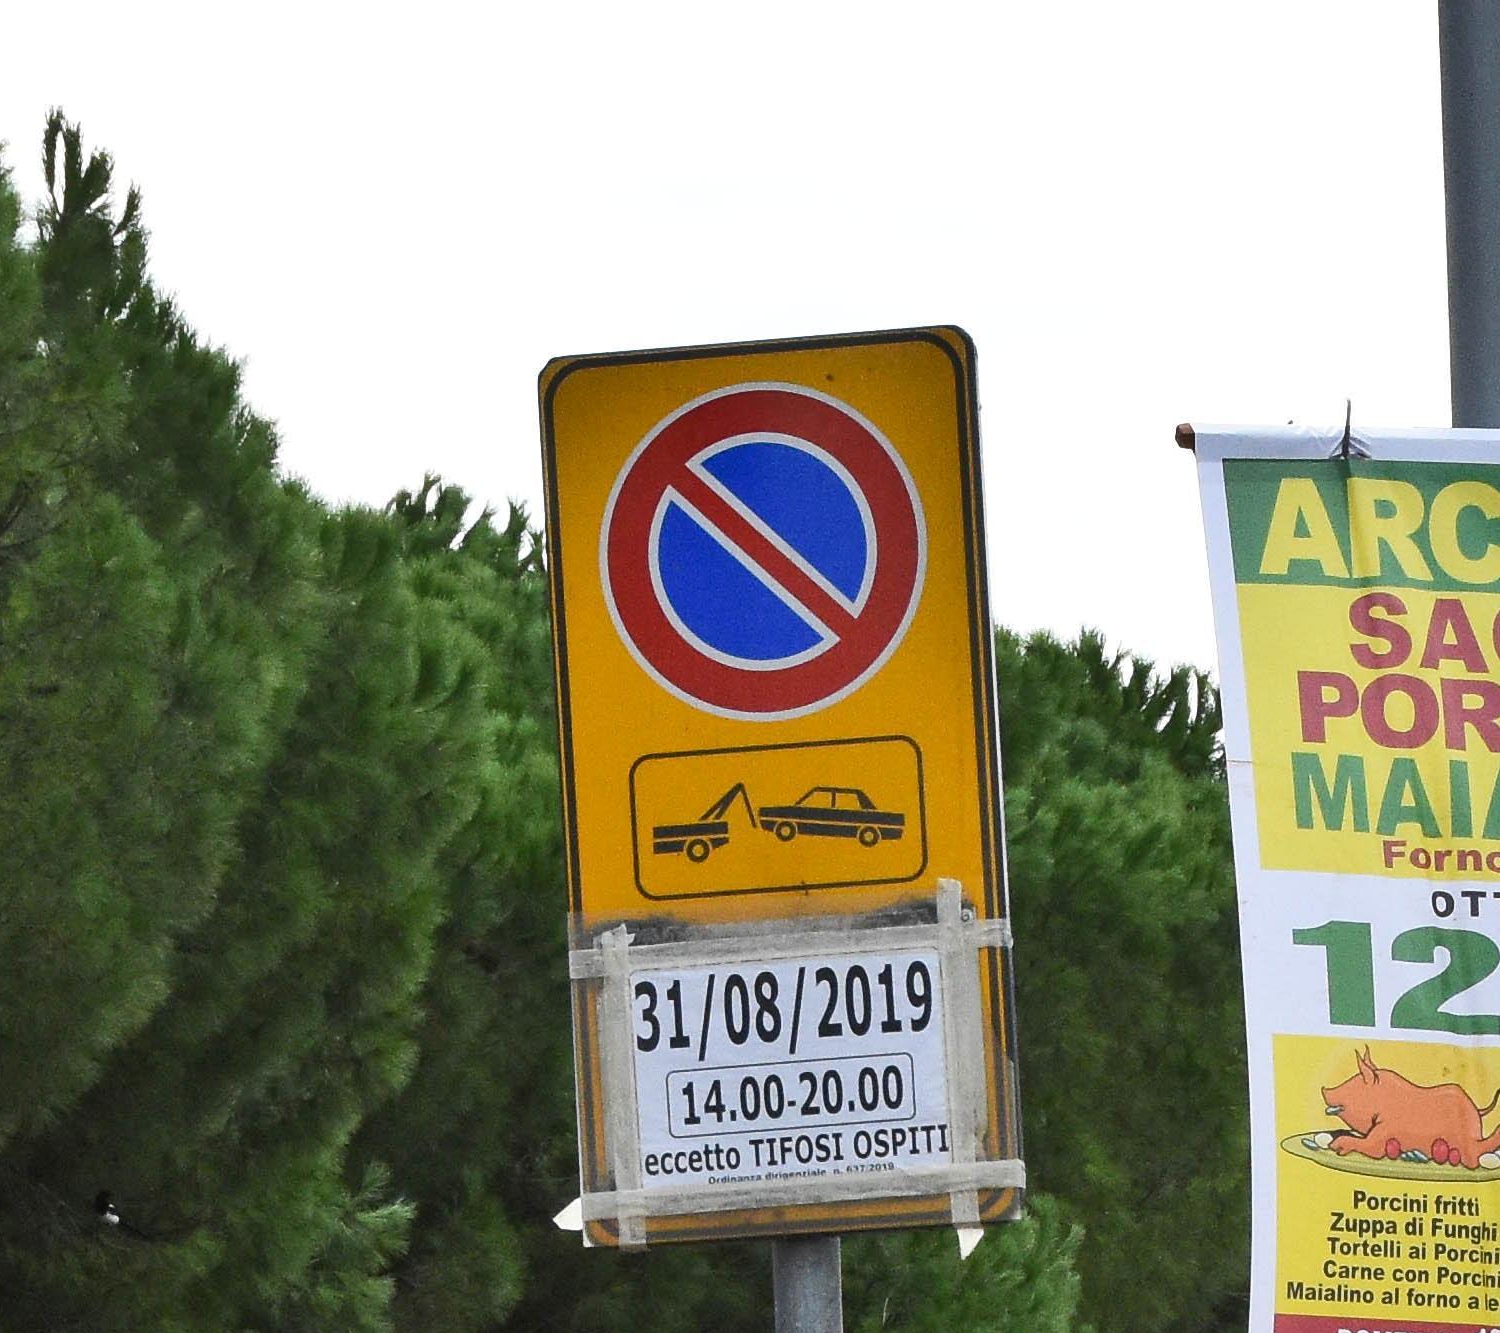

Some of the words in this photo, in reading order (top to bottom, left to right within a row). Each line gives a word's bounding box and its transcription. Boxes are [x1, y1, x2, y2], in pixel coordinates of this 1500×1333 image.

[634, 960, 932, 1061] 31/08/2019
[682, 1065, 903, 1124] 14.00-20.00
[645, 1143, 740, 1175] eccetto
[749, 1132, 844, 1166] TIFOSI
[854, 1123, 949, 1159] OSPITI
[708, 1174, 762, 1185] Ordinanza
[1353, 1190, 1428, 1213] Porcini
[1434, 1195, 1480, 1217] fritti
[1330, 1212, 1397, 1238] Zuppa
[1405, 1218, 1423, 1235] di
[1431, 1219, 1497, 1244] Funghi
[1327, 1237, 1400, 1258] Tortelli
[1408, 1242, 1426, 1260] ai
[1434, 1244, 1500, 1265] Porcini
[1323, 1260, 1385, 1281] Carne
[1392, 1267, 1429, 1283] con
[1286, 1282, 1374, 1304] Maialino
[1381, 1287, 1399, 1305] al
[1407, 1288, 1460, 1310] forno
[1468, 1296, 1479, 1310] a
